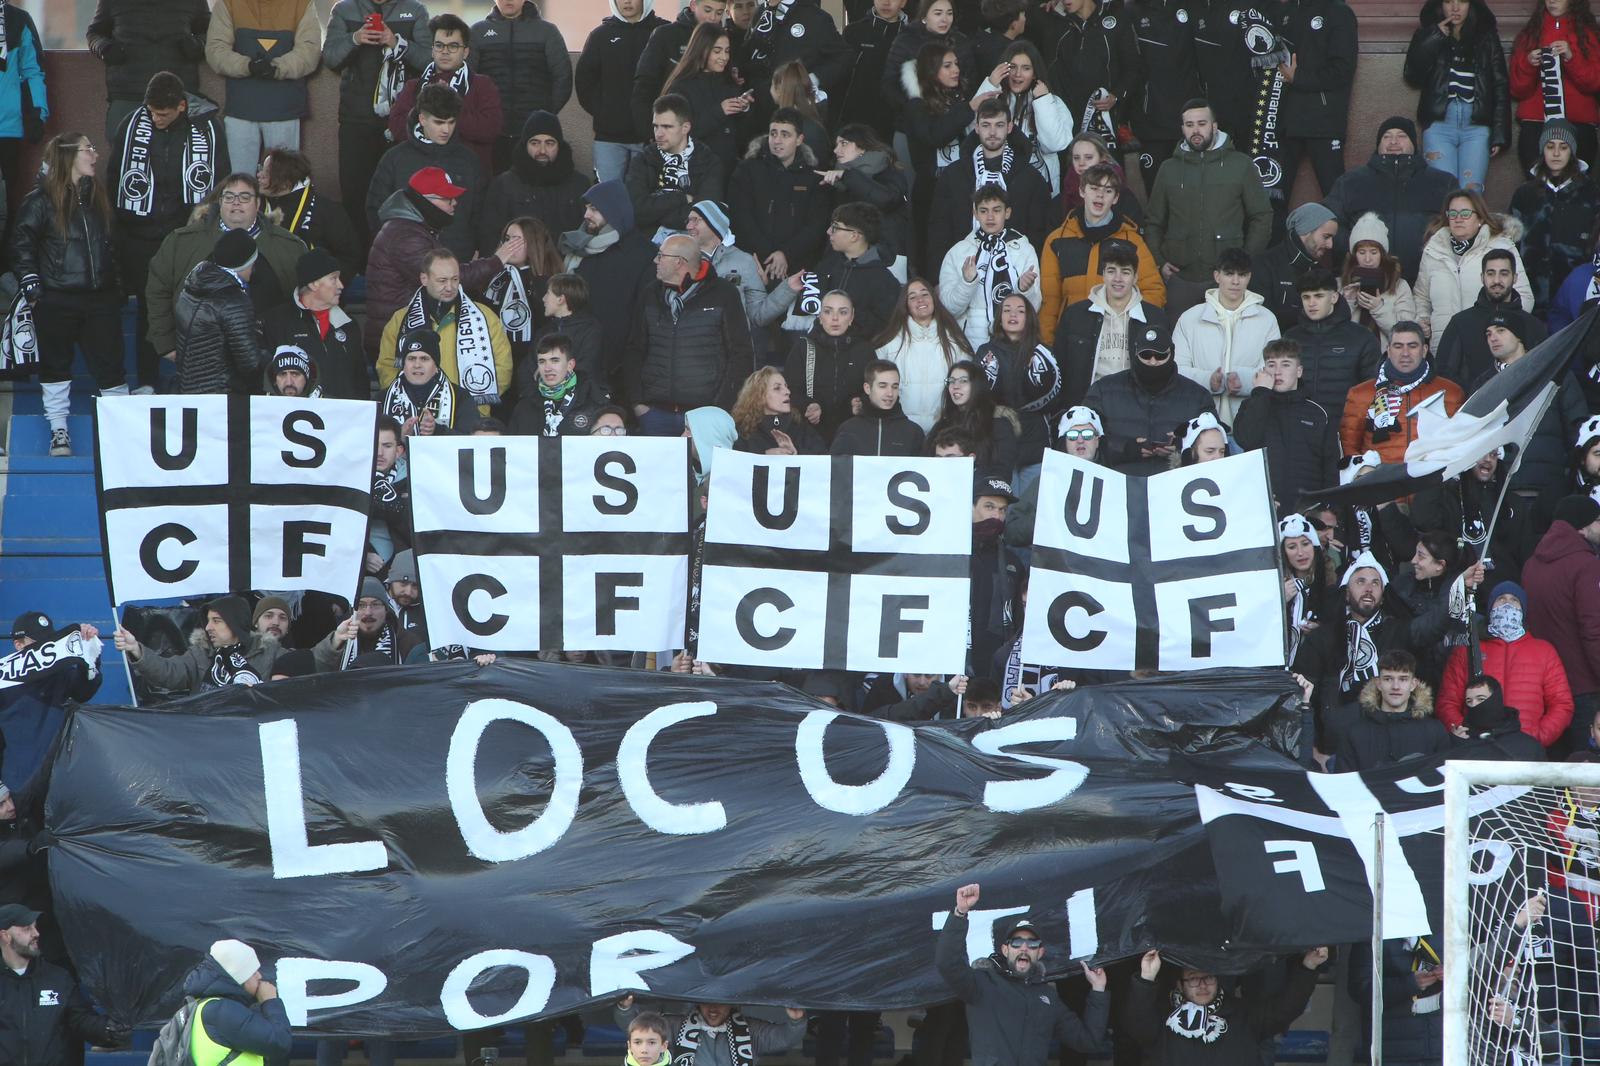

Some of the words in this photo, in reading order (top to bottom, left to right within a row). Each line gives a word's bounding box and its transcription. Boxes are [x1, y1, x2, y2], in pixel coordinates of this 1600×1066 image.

[1269, 66, 1285, 129] alamanca
[150, 408, 197, 470] U
[281, 410, 326, 468] S
[458, 448, 506, 515] U
[593, 451, 638, 515] S
[752, 465, 800, 530] U
[886, 471, 930, 535] S
[1065, 469, 1103, 539] U
[1181, 478, 1226, 541] S
[139, 523, 199, 583] C
[282, 520, 331, 577] F
[452, 574, 509, 636] C
[595, 573, 643, 635] F
[736, 588, 796, 650] C
[879, 595, 929, 658] F
[1047, 591, 1107, 651] C
[1188, 593, 1236, 658] F
[259, 699, 1089, 879] LOCOS
[275, 930, 695, 1030] POR
